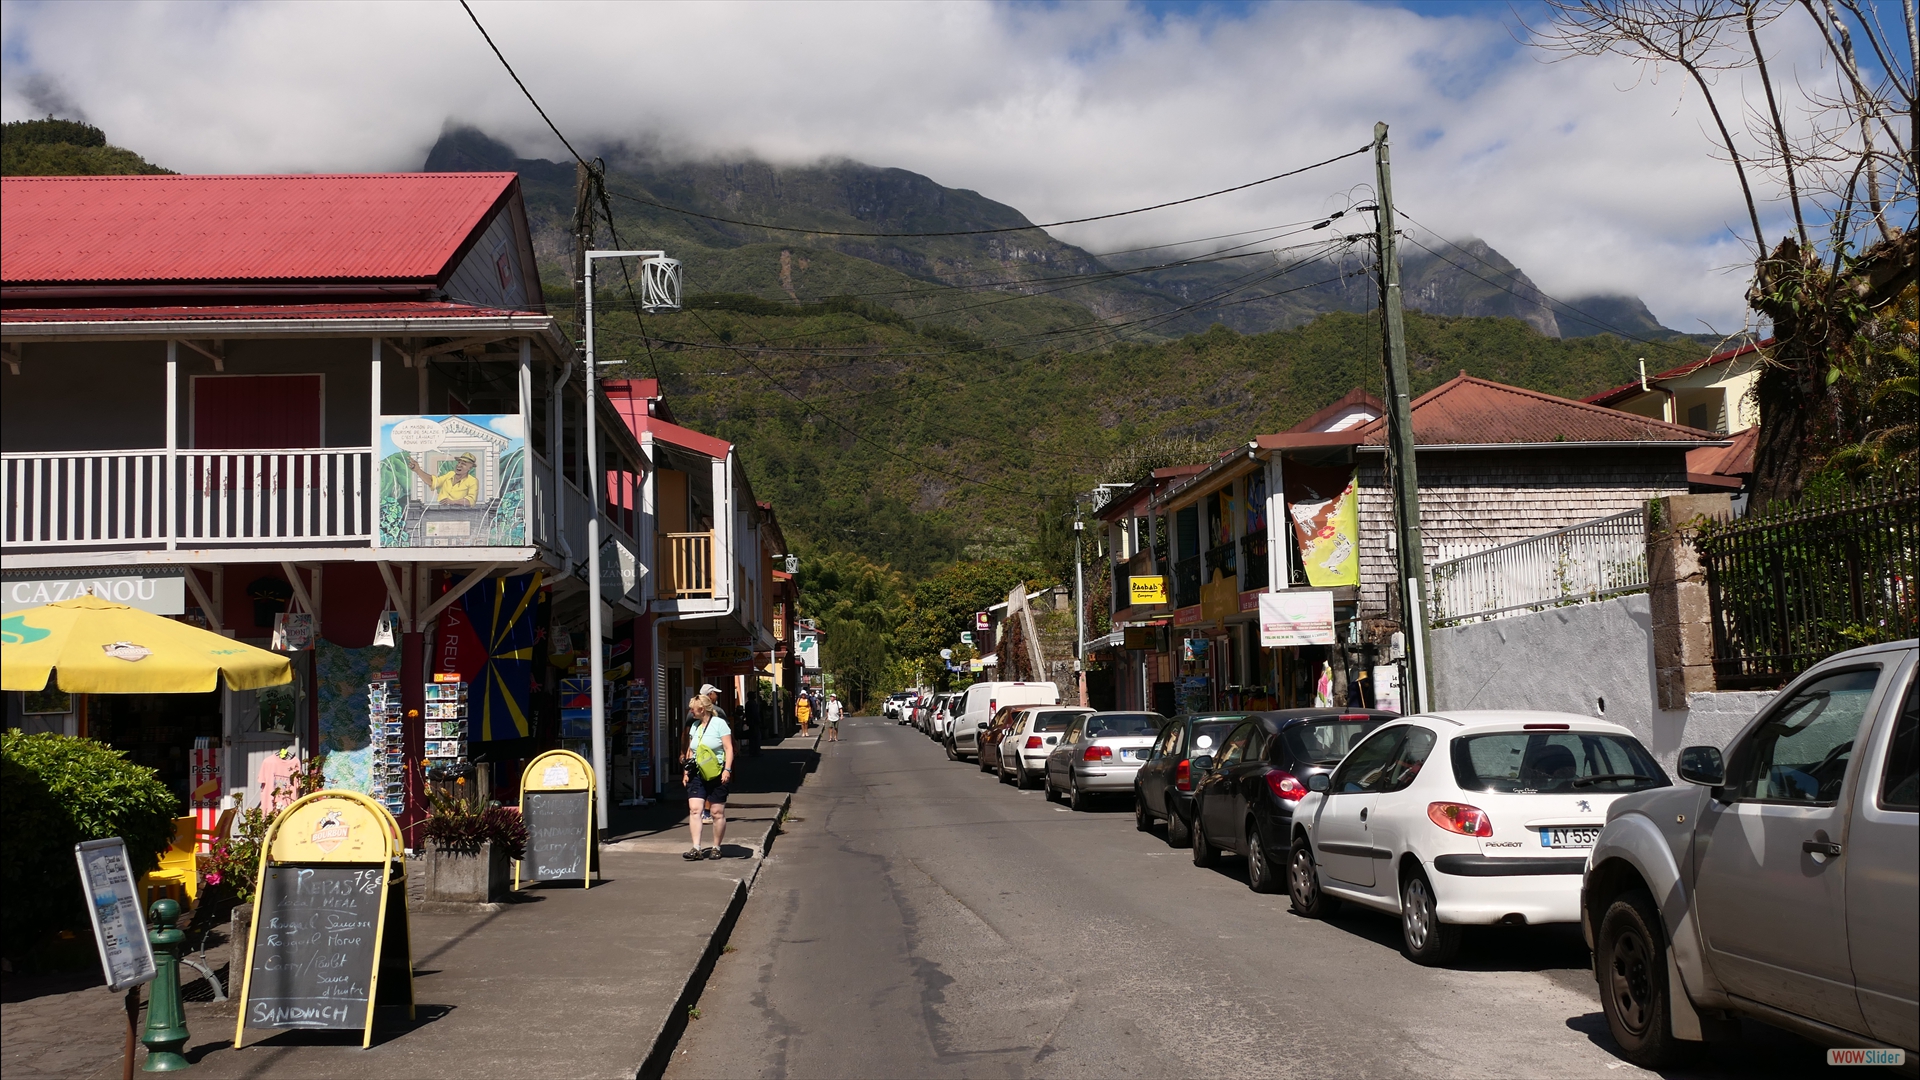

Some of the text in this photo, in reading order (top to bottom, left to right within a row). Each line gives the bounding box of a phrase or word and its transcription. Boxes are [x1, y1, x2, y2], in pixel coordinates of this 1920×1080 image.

[12, 580, 157, 603] CAZANOU
[447, 606, 461, 627] LA
[192, 764, 220, 774] PicSol
[312, 828, 349, 842] BOURBON
[538, 856, 581, 879] Rougail
[296, 869, 353, 896] REPAS
[328, 933, 361, 946] Morue
[317, 971, 349, 984] Sauce
